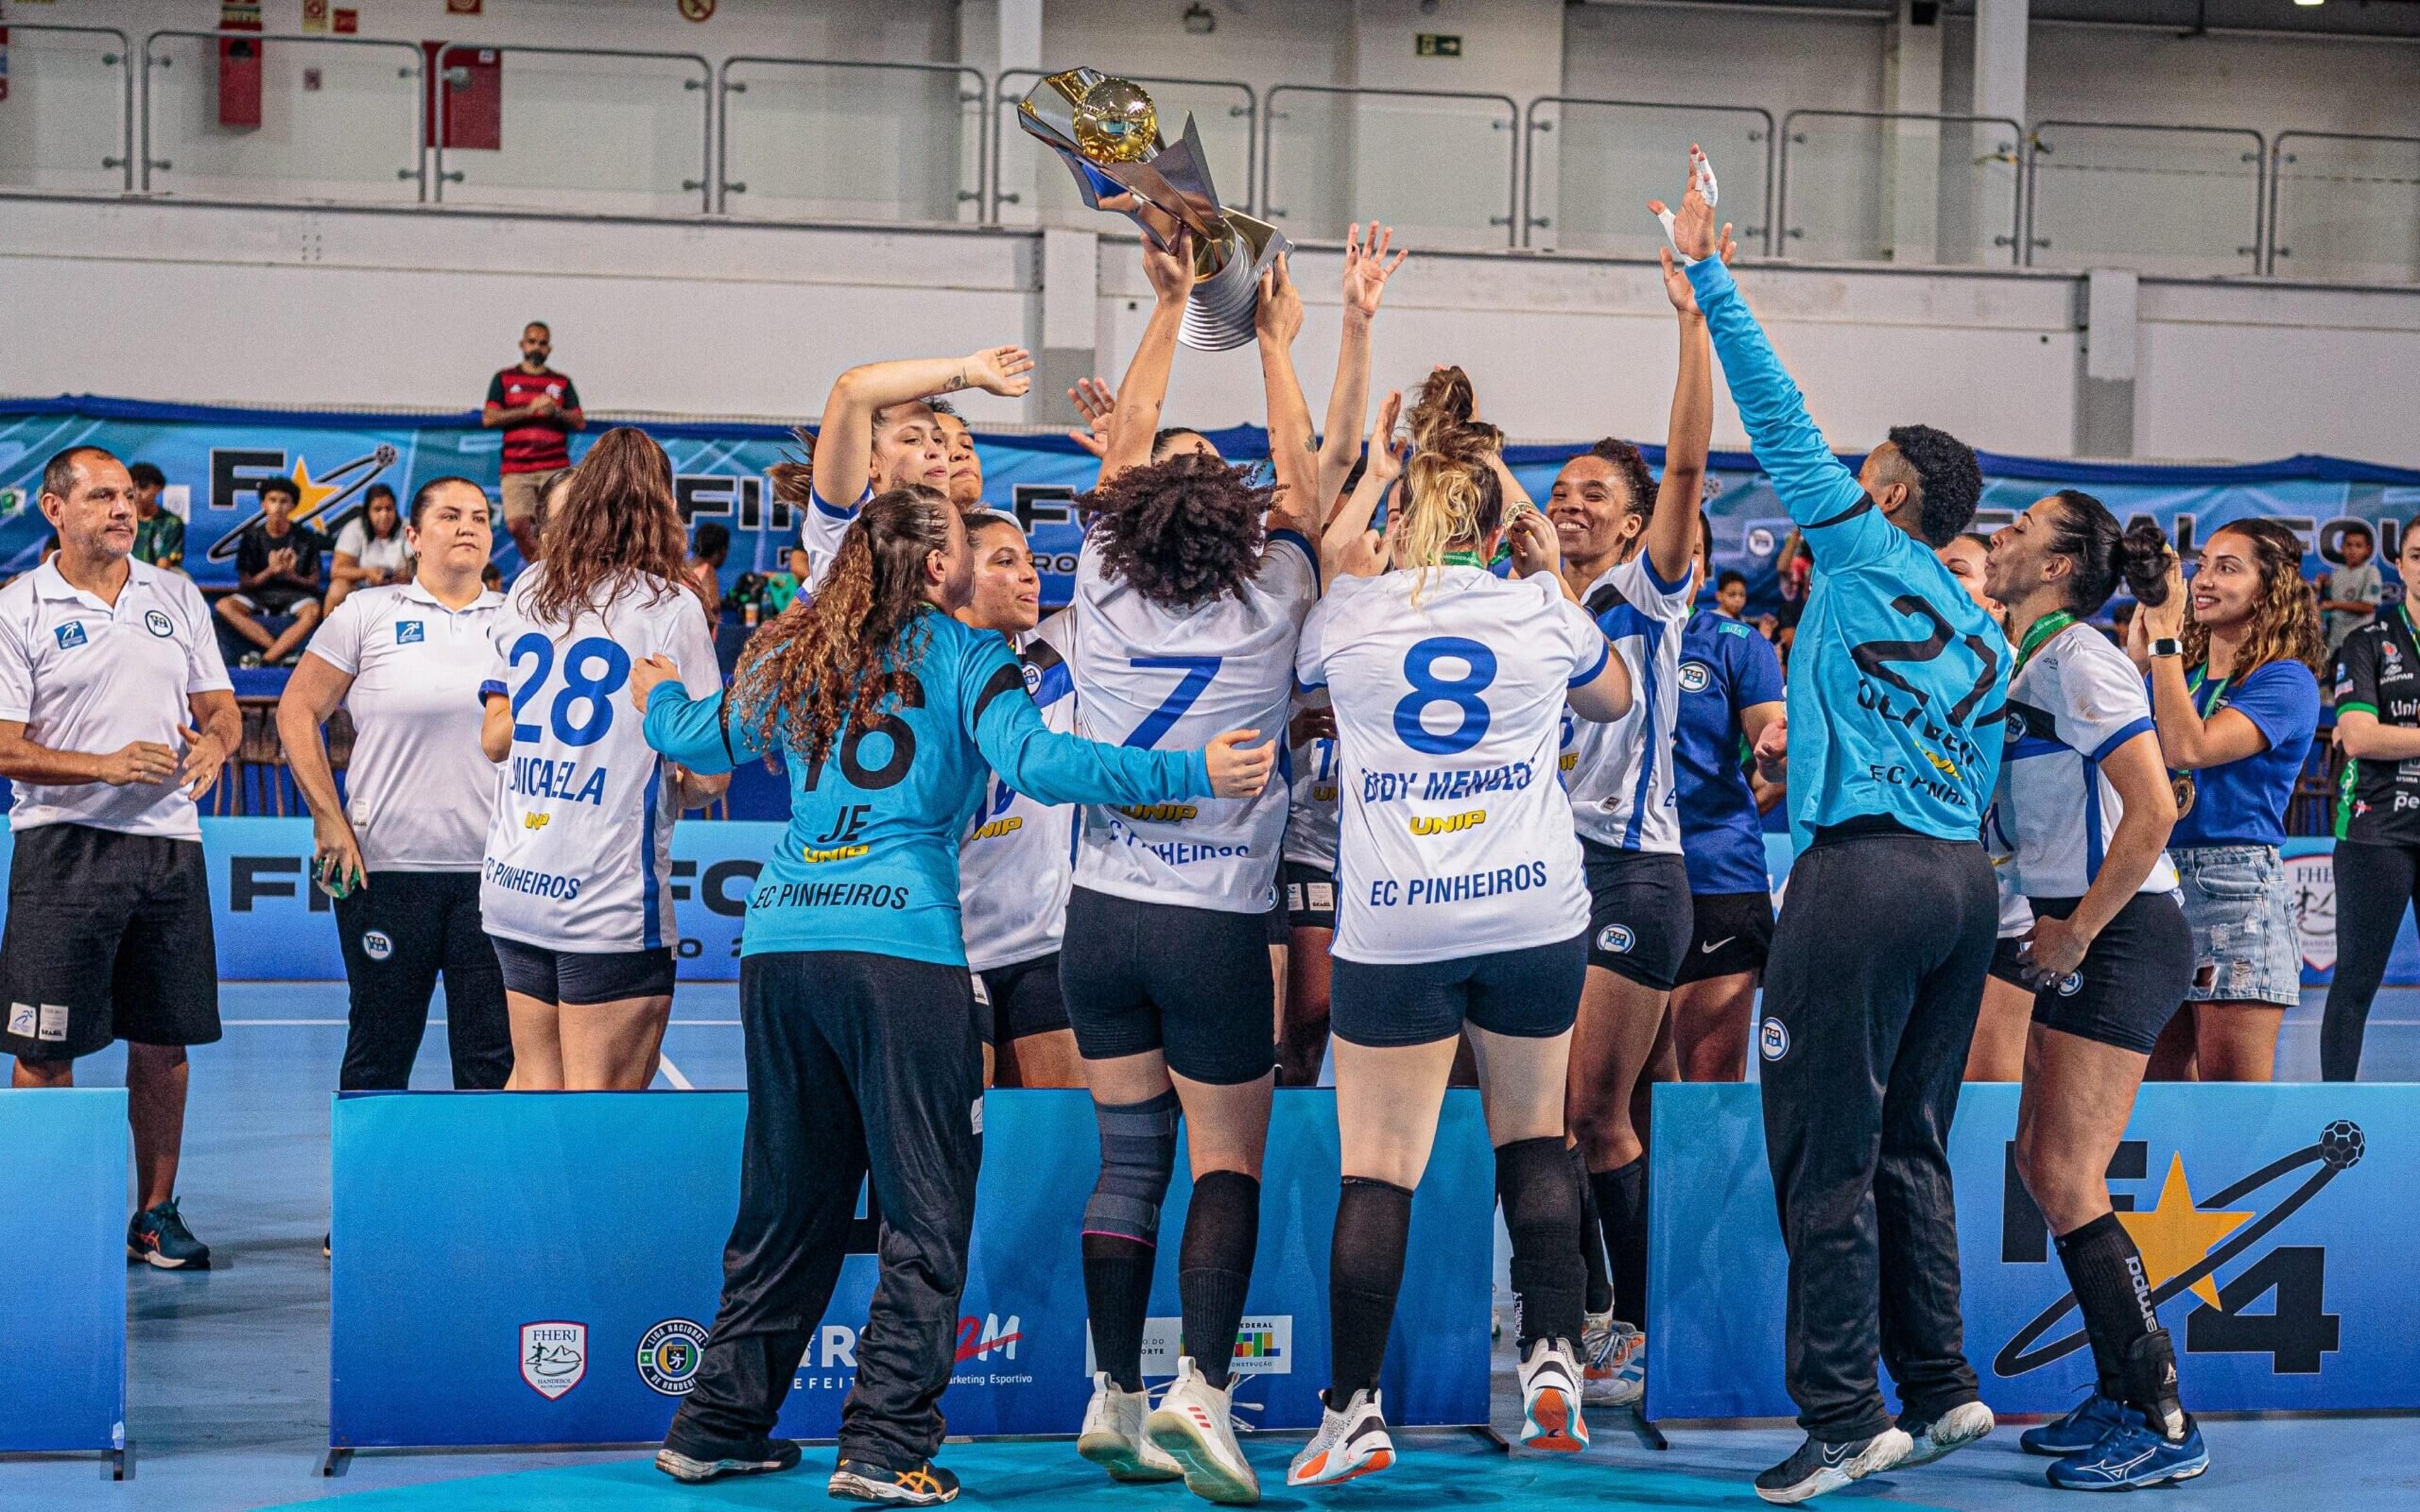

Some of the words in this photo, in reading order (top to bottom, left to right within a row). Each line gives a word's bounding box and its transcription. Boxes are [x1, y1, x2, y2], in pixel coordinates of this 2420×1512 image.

[509, 633, 631, 747] 28
[1121, 656, 1223, 751] 7
[1393, 636, 1497, 755] 8
[817, 805, 872, 843] JE
[1121, 804, 1197, 822] UNIP
[1409, 810, 1486, 836] UNIP
[802, 844, 870, 864] UNIP
[492, 862, 582, 900] PINHEIROS
[1369, 880, 1398, 907] EC
[1406, 860, 1548, 906] PINHEIROS
[752, 886, 776, 909] EC
[778, 883, 910, 910] PINHEIROS
[2185, 1246, 2340, 1374] 4
[533, 1329, 577, 1342] FHERJ
[648, 1328, 666, 1344] LIGA
[667, 1324, 706, 1344] NACIONAL
[651, 1374, 662, 1385] DE
[662, 1377, 697, 1390] HANDEB
[948, 1374, 985, 1387] arketing
[989, 1373, 1033, 1386] Esportivo
